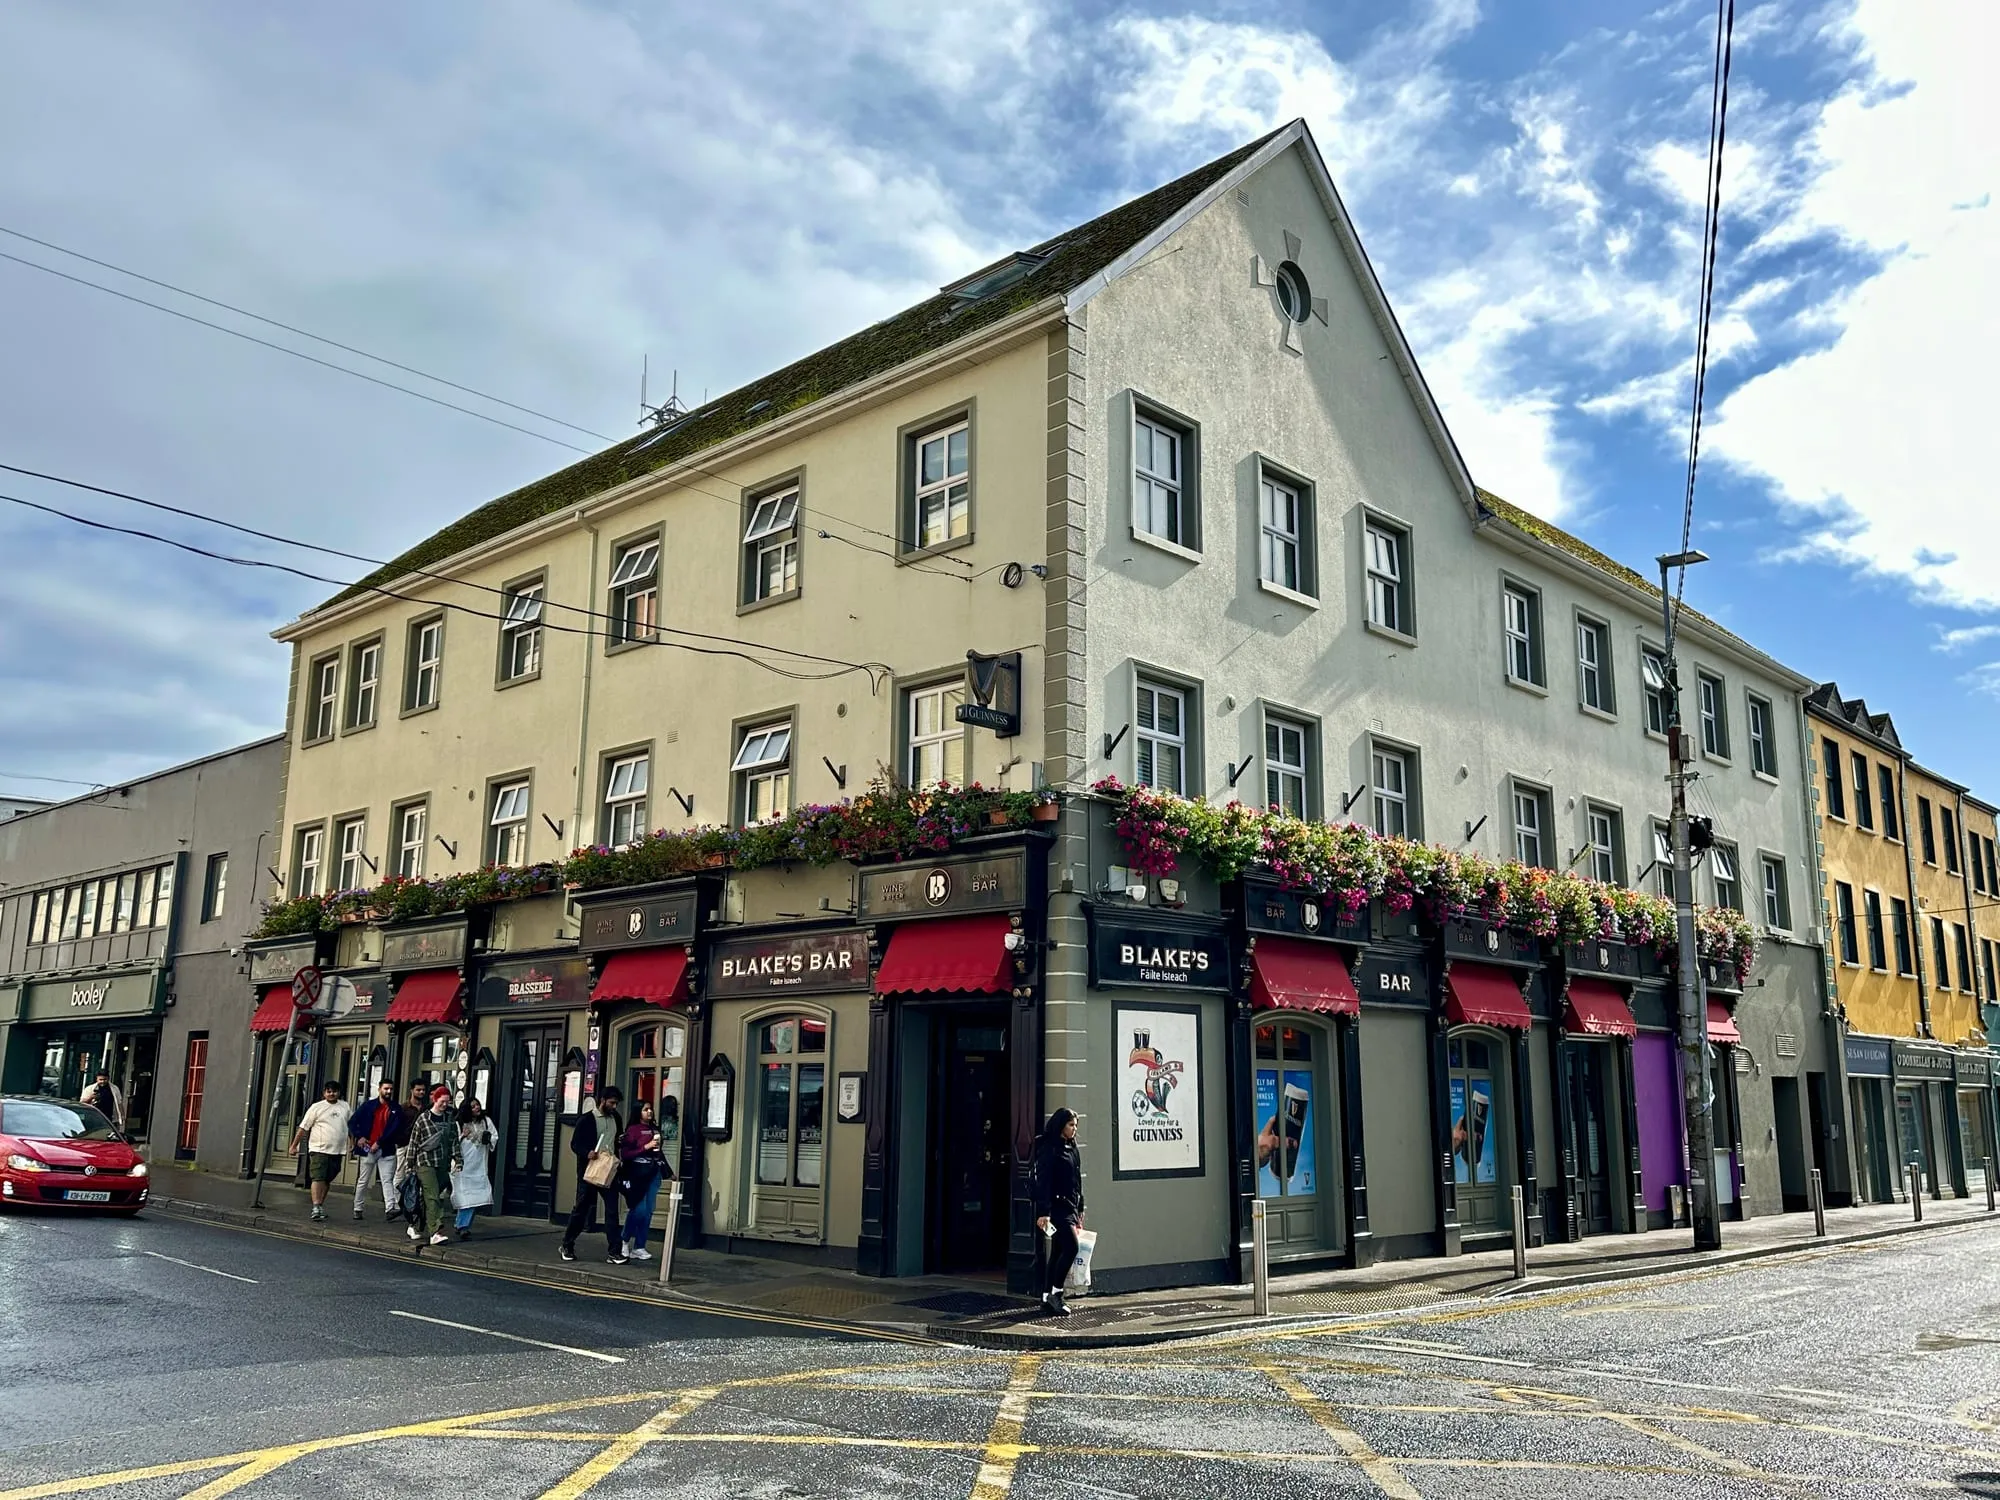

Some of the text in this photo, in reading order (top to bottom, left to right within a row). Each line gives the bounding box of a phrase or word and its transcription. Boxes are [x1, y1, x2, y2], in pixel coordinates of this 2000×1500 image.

[968, 707, 1008, 725] GUINNESS
[881, 883, 904, 894] WINE
[972, 880, 998, 892] BAR
[1266, 907, 1286, 919] BAR
[660, 916, 677, 927] BAR
[722, 951, 852, 977] BLAKE'S BAR
[1120, 944, 1209, 970] BLAKE'S
[1140, 968, 1188, 982] Fáilte Isteach
[1380, 973, 1411, 991] BAR
[508, 980, 553, 996] BRASSERIE
[71, 982, 106, 1010] booley
[1138, 1118, 1156, 1127] Lovely
[1133, 1127, 1183, 1141] GUINNESS
